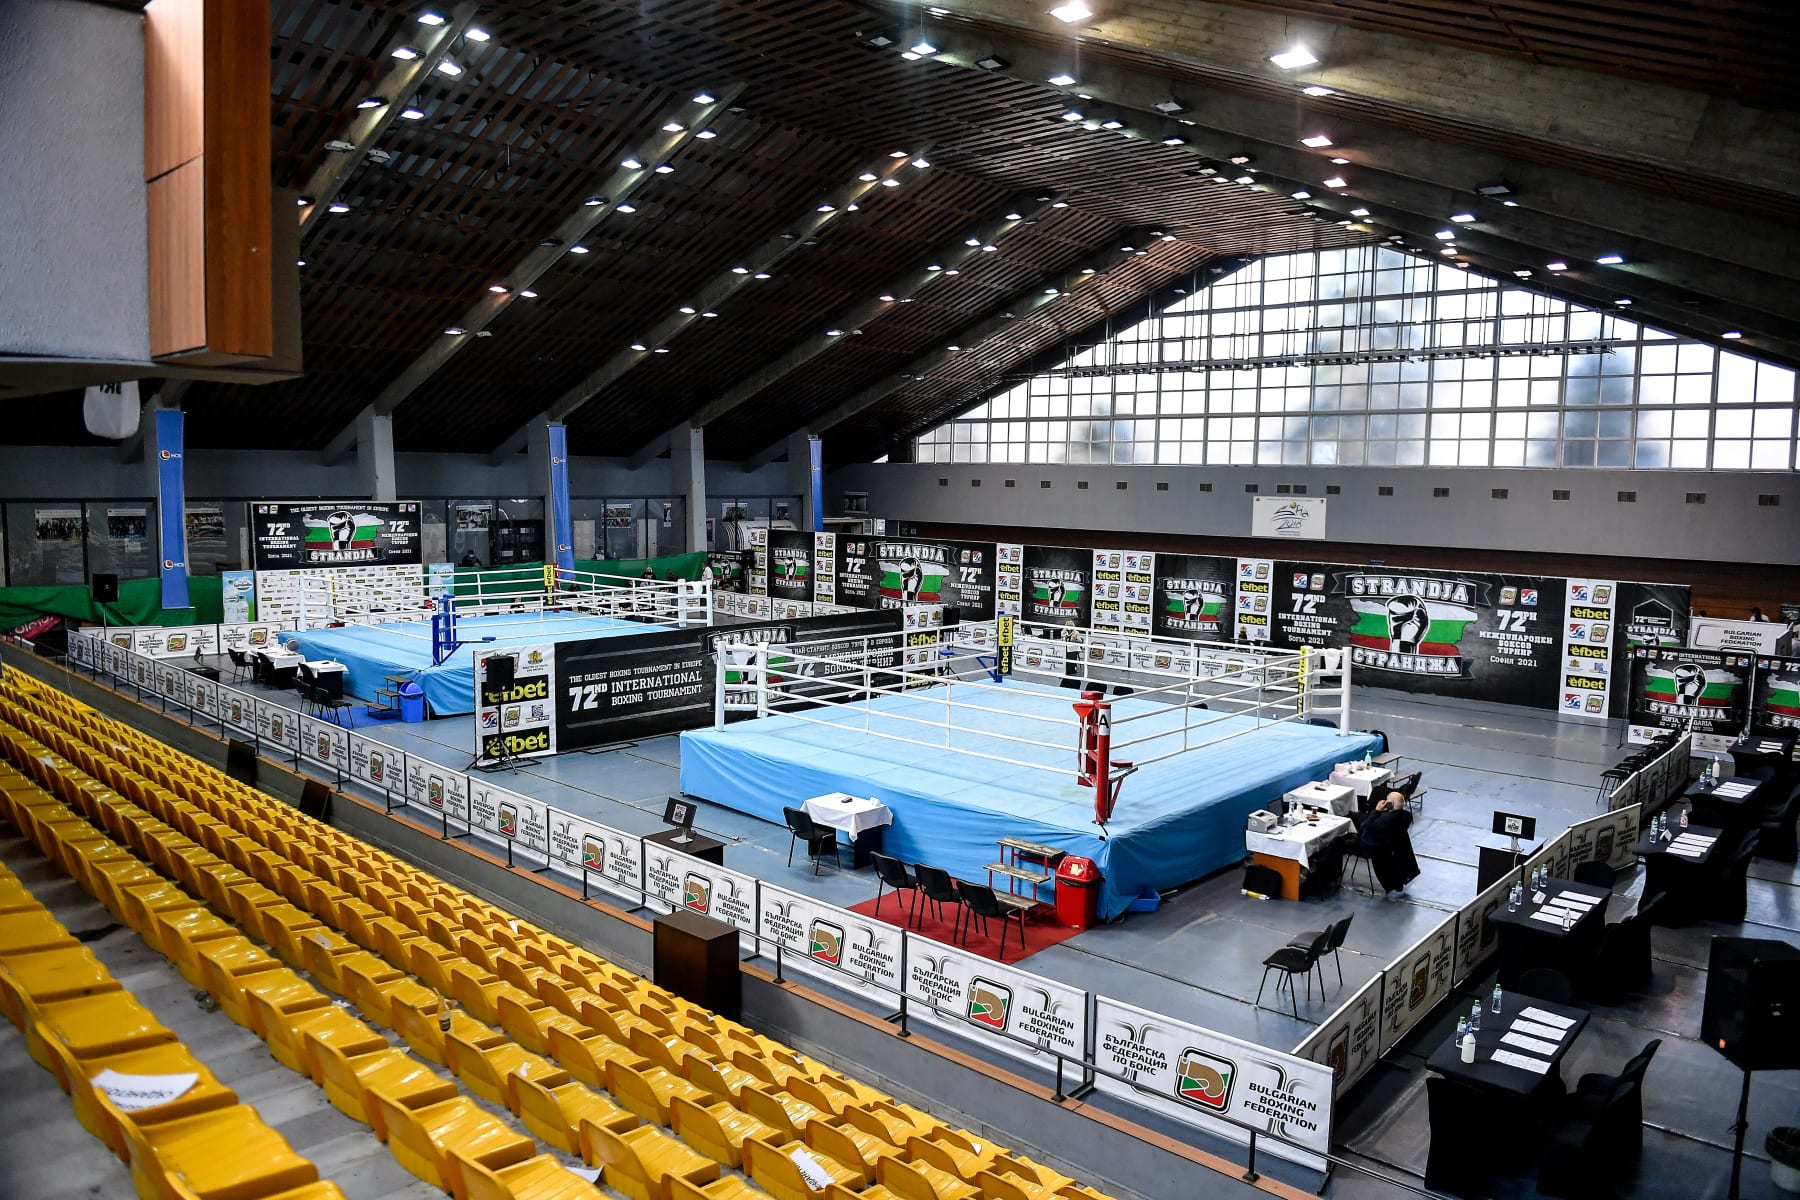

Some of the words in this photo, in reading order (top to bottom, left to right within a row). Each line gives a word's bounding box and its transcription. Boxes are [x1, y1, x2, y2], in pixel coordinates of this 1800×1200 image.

[310, 550, 375, 561] STRANDJA
[774, 550, 807, 560] STRANDJA
[880, 544, 944, 562] STRANDJA
[1000, 564, 1020, 572] efbet
[1033, 570, 1080, 582] STRANDJA
[1097, 572, 1120, 581] efbet
[1127, 574, 1150, 583] efbet
[1167, 580, 1222, 593] STRANDJA
[1242, 583, 1268, 592] efbet
[1352, 577, 1469, 603] STRANDJA
[1000, 592, 1020, 600] efbet
[1292, 593, 1326, 614] 72ND
[1096, 602, 1119, 610] efbet
[1126, 604, 1150, 612] efbet
[1572, 606, 1609, 620] efbet
[1167, 618, 1218, 631] СТРАНДЖА
[1240, 615, 1267, 624] efbet
[1278, 613, 1338, 624] INTERNATIONAL
[1294, 621, 1320, 629] BOXING
[1497, 610, 1537, 632] 72РН
[1282, 626, 1332, 636] TOURNAMENT
[1480, 630, 1552, 644] МЕЖДУНАРОДЕН
[1628, 626, 1676, 636] STRANDJA
[1308, 636, 1324, 644] 2021
[1498, 640, 1532, 650] БОКСОВ
[1497, 647, 1532, 656] ТУРНИР
[1570, 645, 1606, 658] efbet
[1352, 648, 1458, 672] СТРАНДЖА
[1518, 659, 1537, 667] 2021
[584, 672, 606, 682] OLDEST
[610, 668, 632, 678] BOXING
[634, 664, 672, 675] TOURNAMENT
[682, 660, 702, 668] EUROPE
[1568, 676, 1605, 690] efbet
[569, 683, 608, 712] 72ND
[612, 671, 702, 694] INTERNATIONAL
[612, 694, 643, 706] BOXING
[648, 684, 702, 700] TOURNAMENT
[1650, 702, 1726, 719] STRANDJA
[1098, 714, 1109, 728] A
[486, 732, 547, 756] efbet
[610, 852, 636, 866] BULGARIAN
[614, 860, 632, 870] BOXING
[608, 864, 638, 879] FEDERATION
[650, 866, 678, 882] БЪЛГАРСКА
[648, 872, 680, 890] ФЕДЕРАЦИЯ
[661, 884, 675, 894] БОКС
[718, 893, 750, 910] BULGARIAN
[722, 902, 744, 915] BOXING
[716, 906, 750, 924] FEDERATION
[766, 911, 802, 929] БЪЛГАРСКА
[764, 918, 804, 938] ФЕДЕРАЦИЯ
[770, 927, 780, 936] ПО
[780, 931, 798, 942] БОКС
[852, 943, 894, 962] BULGARIAN
[860, 952, 886, 968] BOXING
[850, 958, 894, 978] FEDERATION
[914, 966, 960, 988] БЪЛГАРСКА
[912, 974, 961, 997] ФЕДЕРАЦИЯ
[920, 984, 930, 994] ПО
[932, 990, 952, 1003] БОКС
[1022, 1006, 1074, 1030] BULGARIAN
[1030, 1018, 1064, 1035] BOXING
[1019, 1022, 1074, 1048] FEDERATION
[1105, 1034, 1166, 1060] БЪЛГАРСКА
[1102, 1043, 1168, 1070] ФЕДЕРАЦИЯ
[1112, 1055, 1128, 1066] ПО
[1129, 1060, 1157, 1076] БОКС
[1248, 1082, 1316, 1112] BULGARIAN
[1260, 1096, 1304, 1118] BOXING
[1244, 1100, 1318, 1132] FEDERATION
